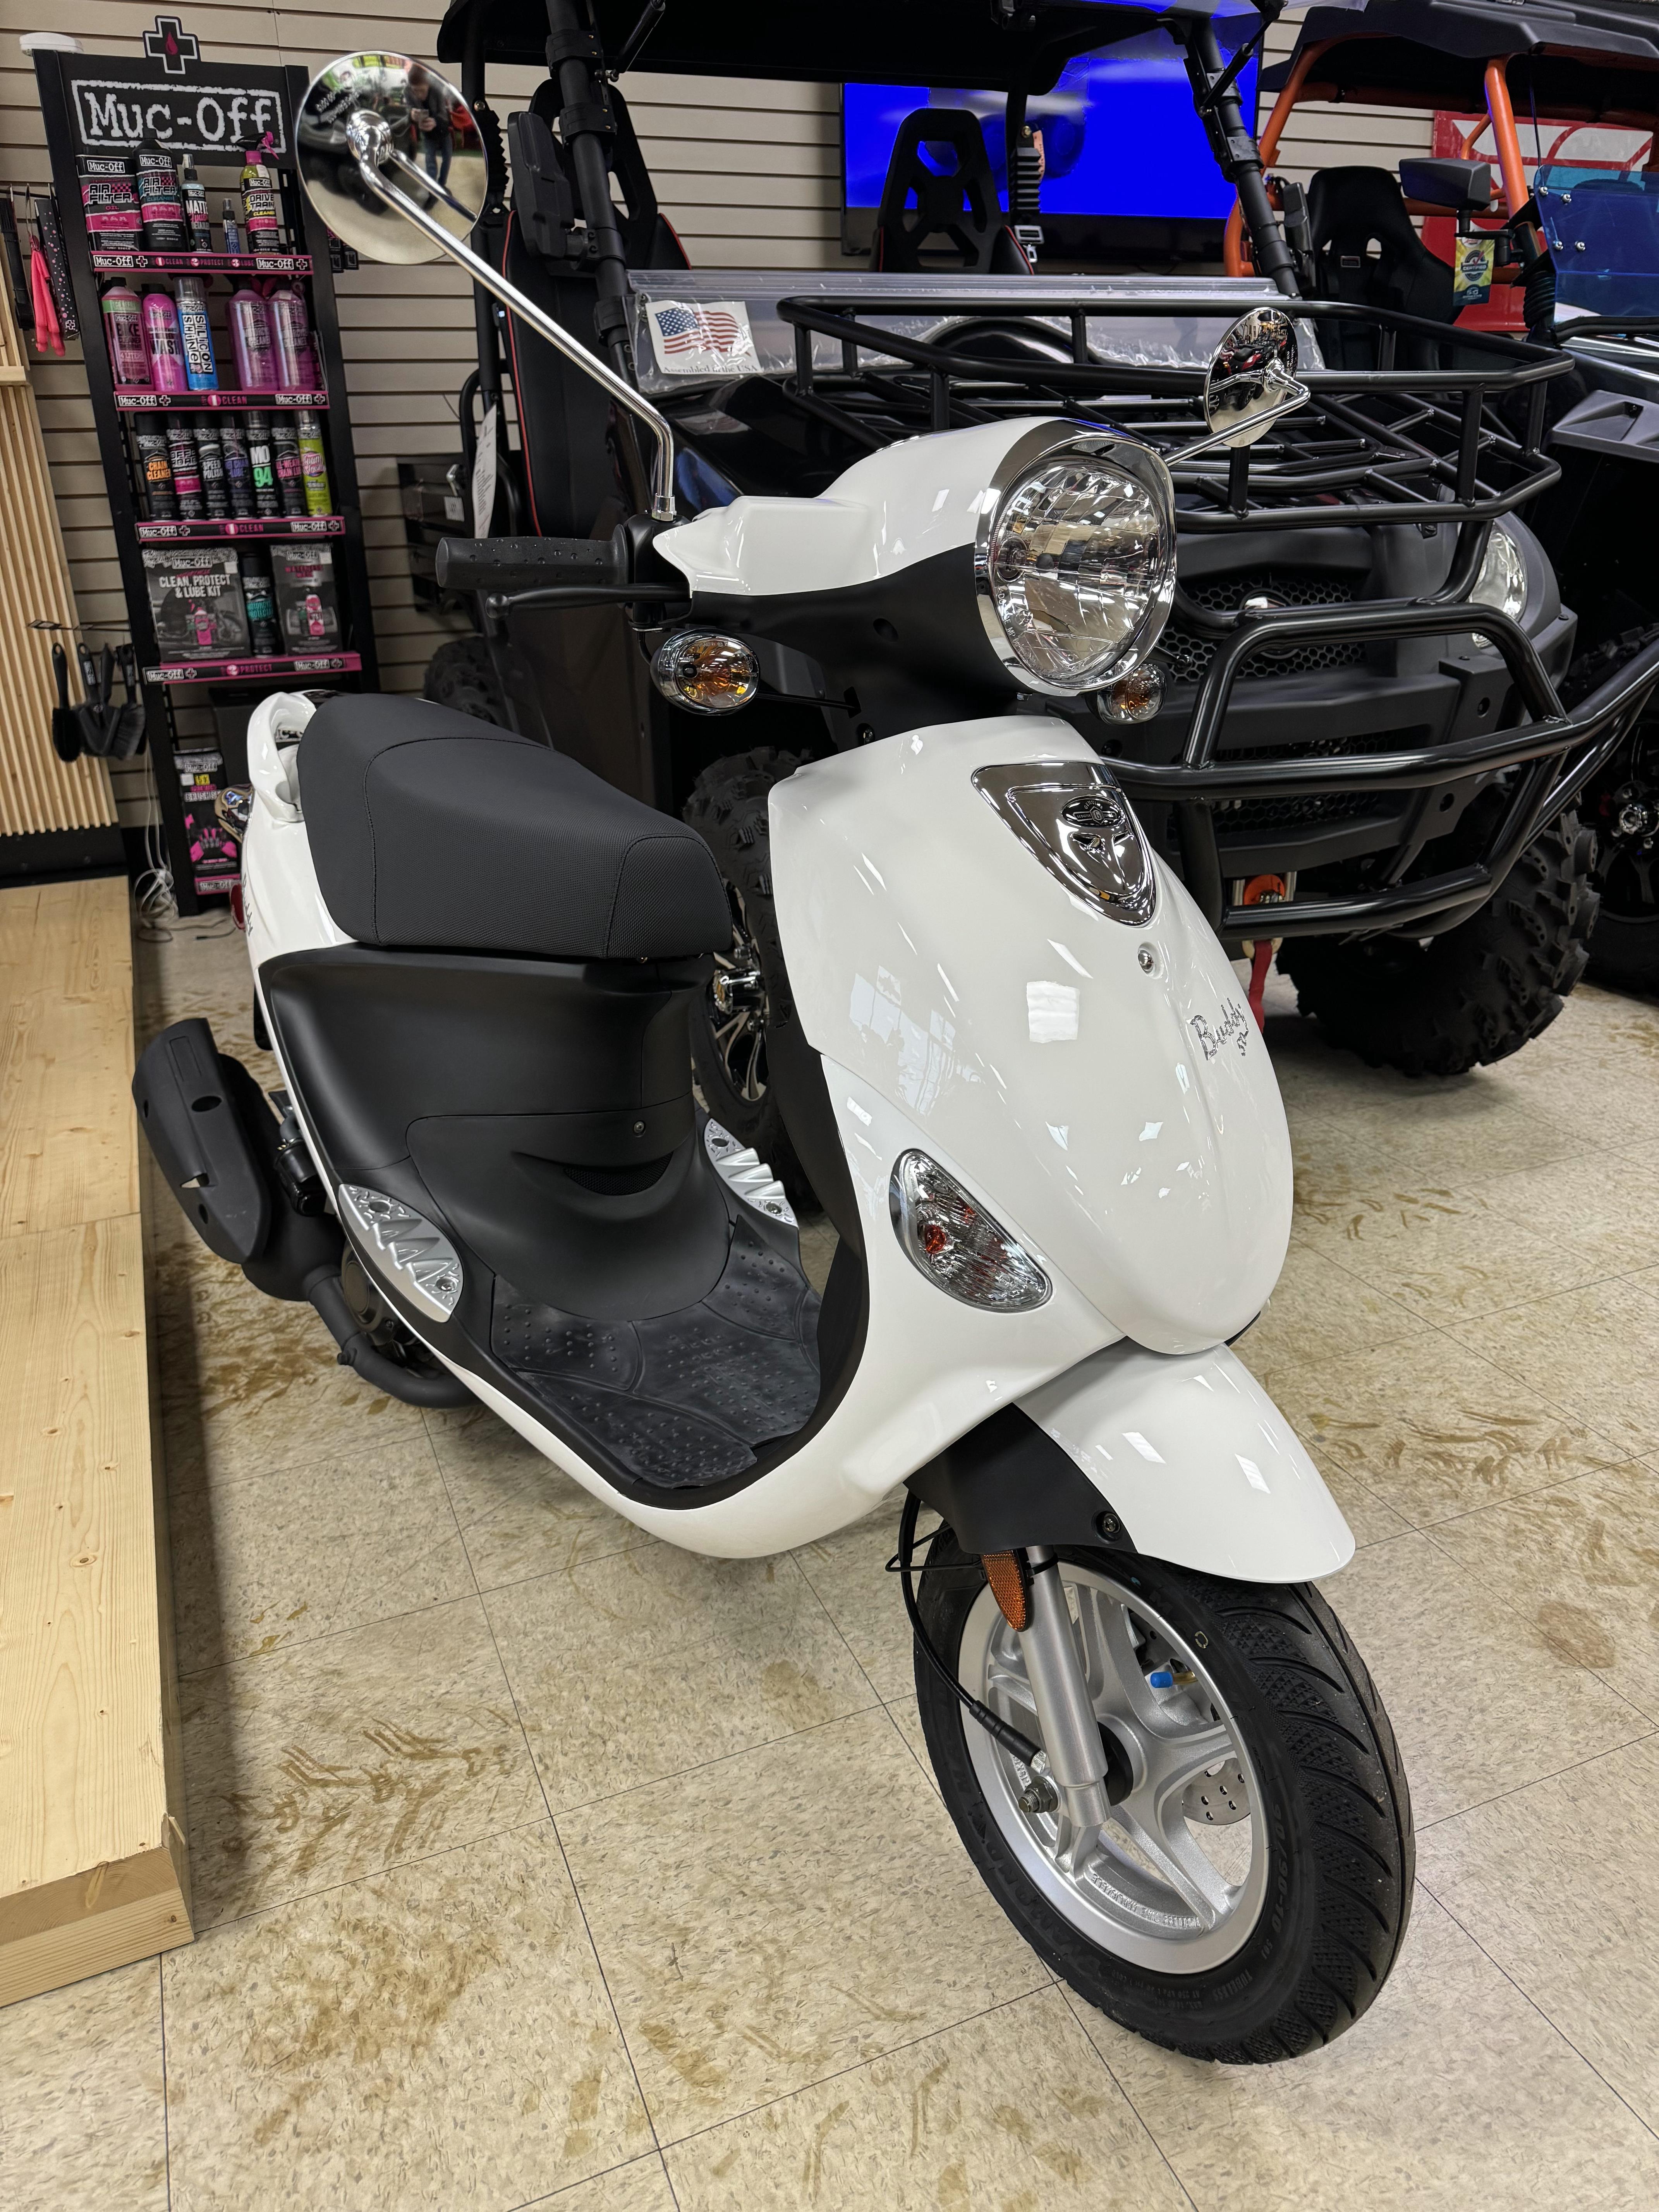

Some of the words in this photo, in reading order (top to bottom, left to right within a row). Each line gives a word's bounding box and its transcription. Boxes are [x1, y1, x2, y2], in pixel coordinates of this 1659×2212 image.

[84, 92, 272, 142] Muc-Off
[141, 156, 171, 166] Muc-Off
[89, 163, 123, 172] Muc-Off
[144, 177, 161, 187] AIR
[89, 184, 111, 194] AIR
[144, 186, 177, 196] FILTER
[89, 193, 132, 204] FILTER
[95, 257, 132, 266] Muc-Off
[192, 258, 198, 267] 2
[232, 259, 239, 267] 3
[258, 260, 292, 268] Muc-Off
[121, 396, 156, 405] Muc-Off
[222, 396, 247, 404] CLEAN
[277, 395, 311, 404] Muc-Off
[253, 466, 273, 488] 94
[141, 527, 175, 537] Muc-Off
[175, 556, 210, 567] Muc-Off
[159, 576, 192, 588] CLEAN,
[193, 574, 230, 586] PROTECT
[175, 586, 183, 598] &
[183, 586, 206, 597] LUBE
[207, 585, 221, 596] KIT
[1084, 800, 1103, 810] GENUIE
[1093, 810, 1102, 820] G
[1190, 998, 1249, 1060] Buddy
[1272, 1803, 1289, 1934] 90/90-10
